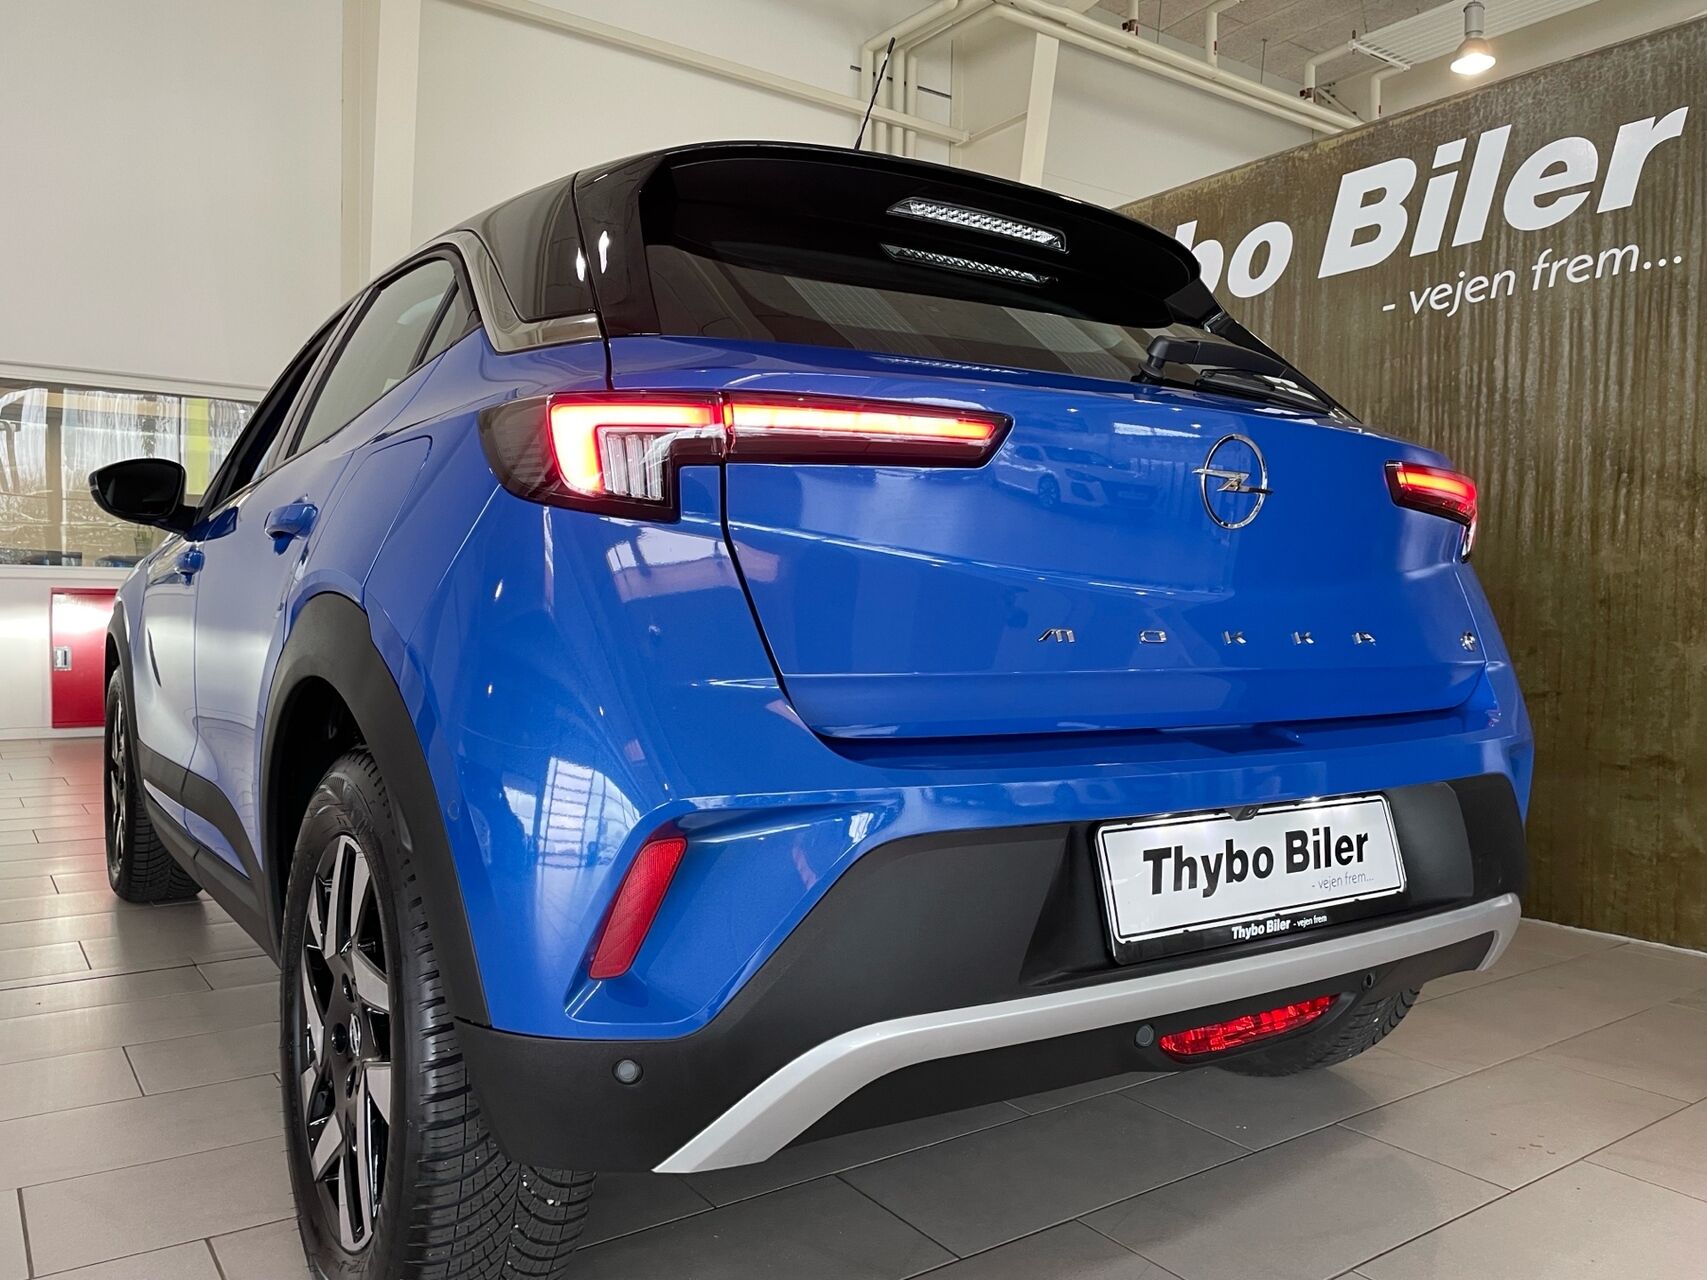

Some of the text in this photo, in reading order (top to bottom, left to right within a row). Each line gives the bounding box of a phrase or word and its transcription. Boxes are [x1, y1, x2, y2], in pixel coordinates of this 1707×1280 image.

[1317, 106, 1689, 279] Biler
[1408, 266, 1516, 318] vejen
[1531, 243, 1683, 292] frem...
[1038, 627, 1377, 646] MOKKA
[1143, 826, 1369, 898] Thybo Biler
[1318, 876, 1343, 891] vejen
[1231, 923, 1265, 940] Thybo
[1266, 918, 1291, 934] Biler
[1297, 917, 1313, 928] vejen
[1313, 914, 1328, 924] frem
